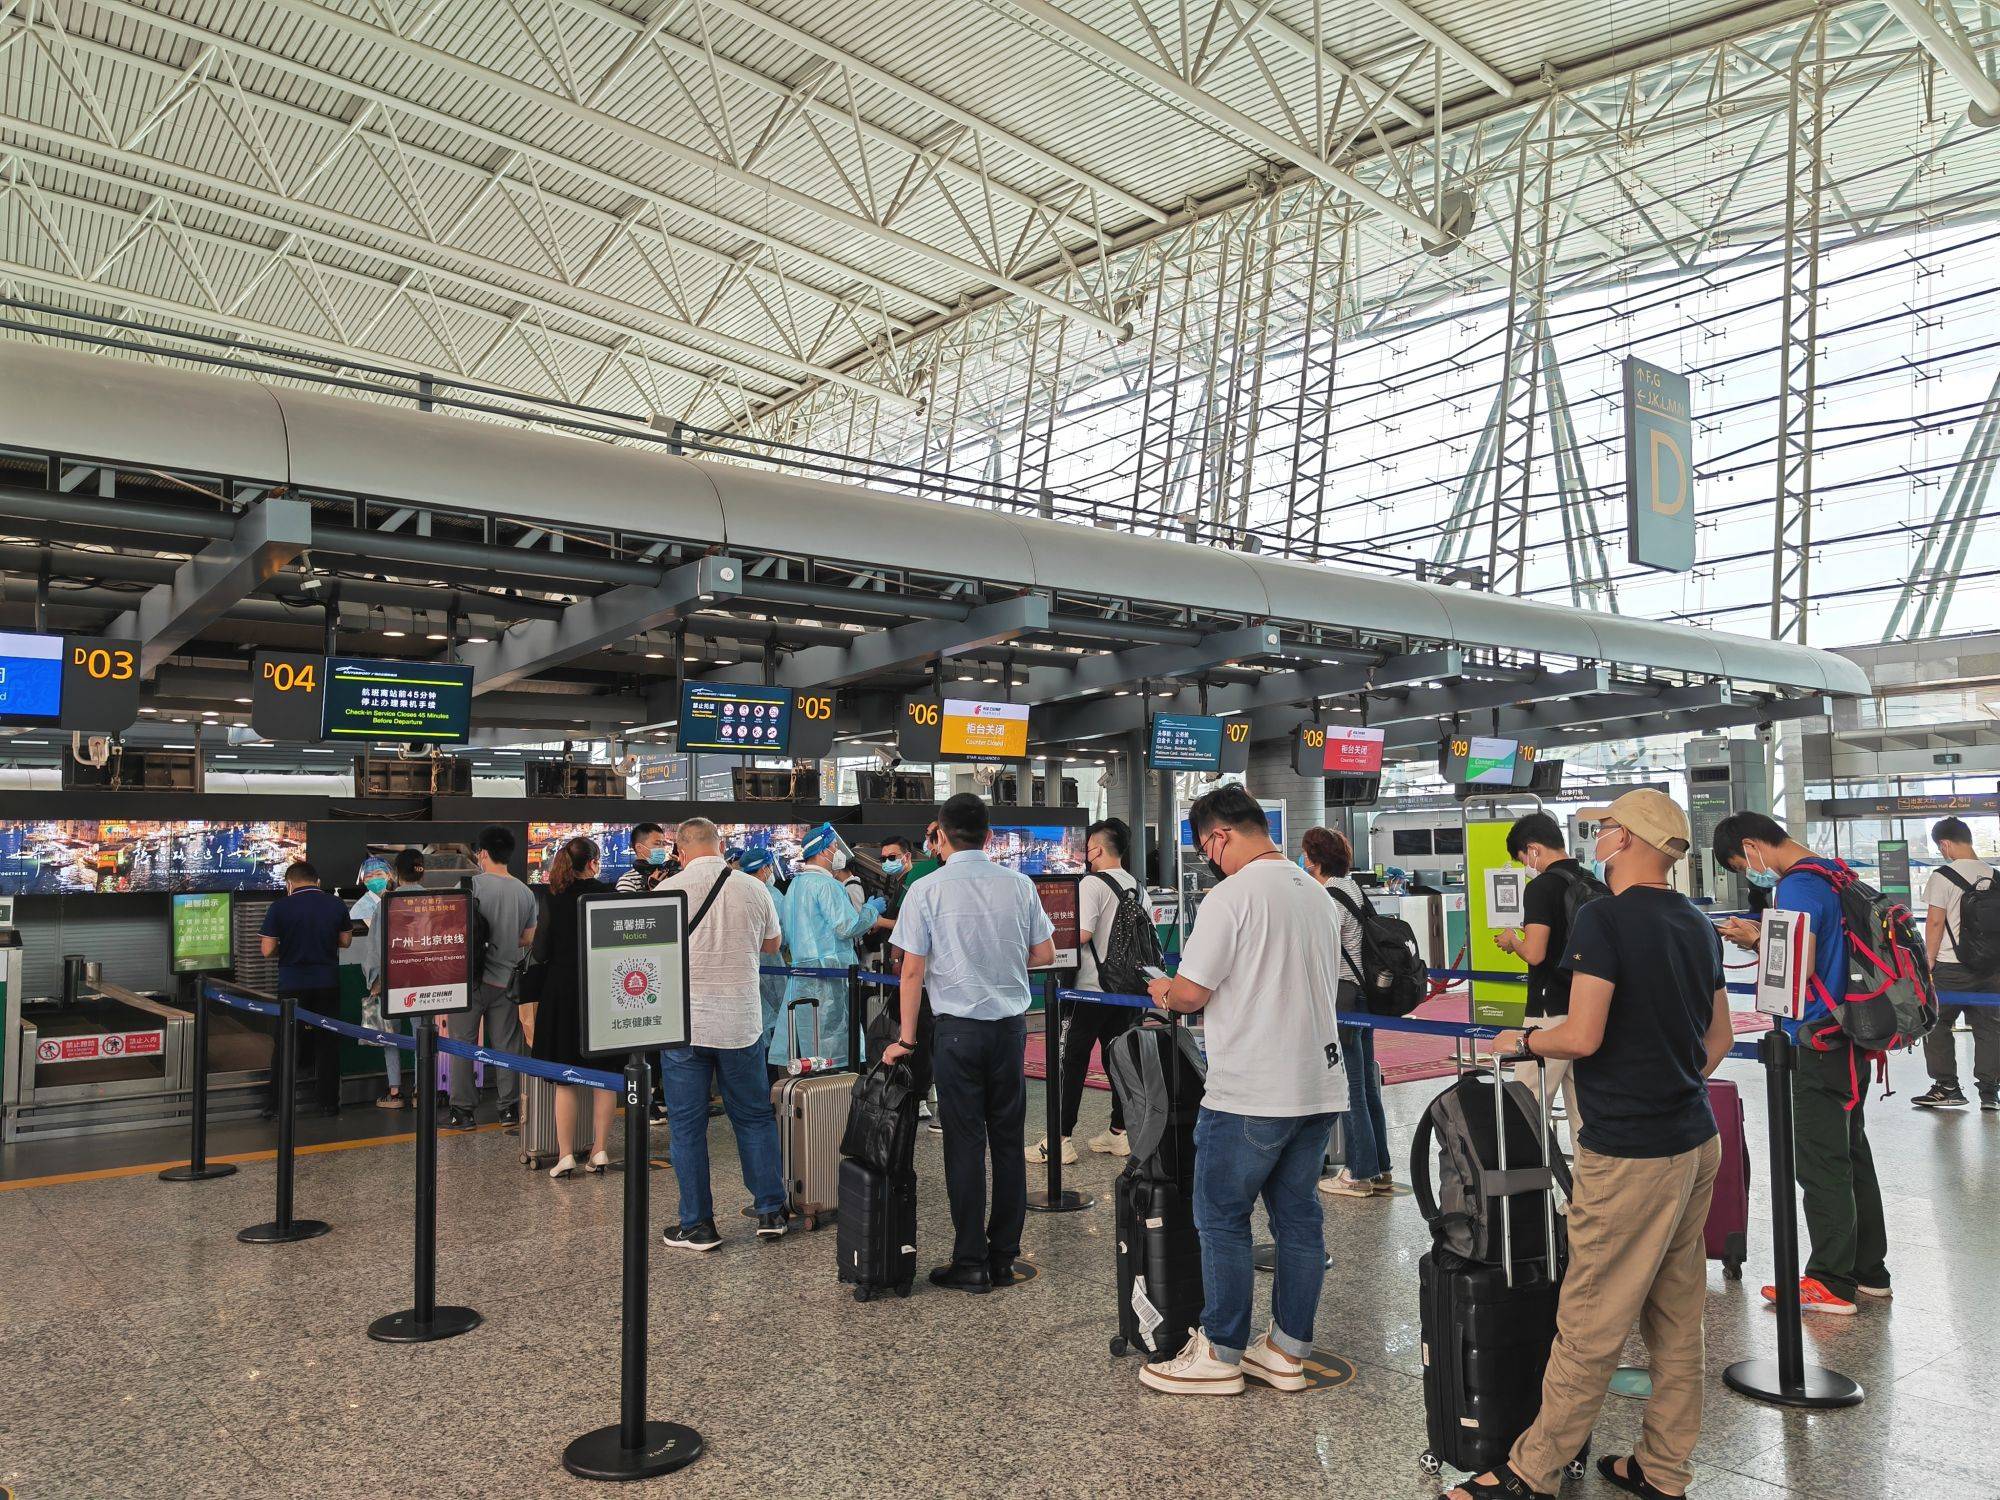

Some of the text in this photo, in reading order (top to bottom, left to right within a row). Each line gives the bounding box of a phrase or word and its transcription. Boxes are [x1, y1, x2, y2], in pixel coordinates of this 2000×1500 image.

[1650, 429, 1687, 516] D
[74, 648, 134, 680] D03
[264, 662, 316, 692] D04
[345, 708, 372, 716] Check-in
[373, 709, 396, 717] Service
[798, 696, 832, 720] D05
[908, 703, 938, 726] D06
[393, 718, 423, 726] Departure
[966, 723, 1005, 736] 柜台关闭
[1226, 724, 1249, 743] D07
[1303, 730, 1324, 747] D08
[1341, 745, 1368, 754] 柜台关闭
[1948, 796, 1958, 808] 2
[612, 918, 656, 931] 温馨提示
[622, 932, 647, 940] Notice
[431, 990, 453, 998] CHINA
[611, 1015, 663, 1030] 北京健康宝
[1324, 1042, 1339, 1070] B
